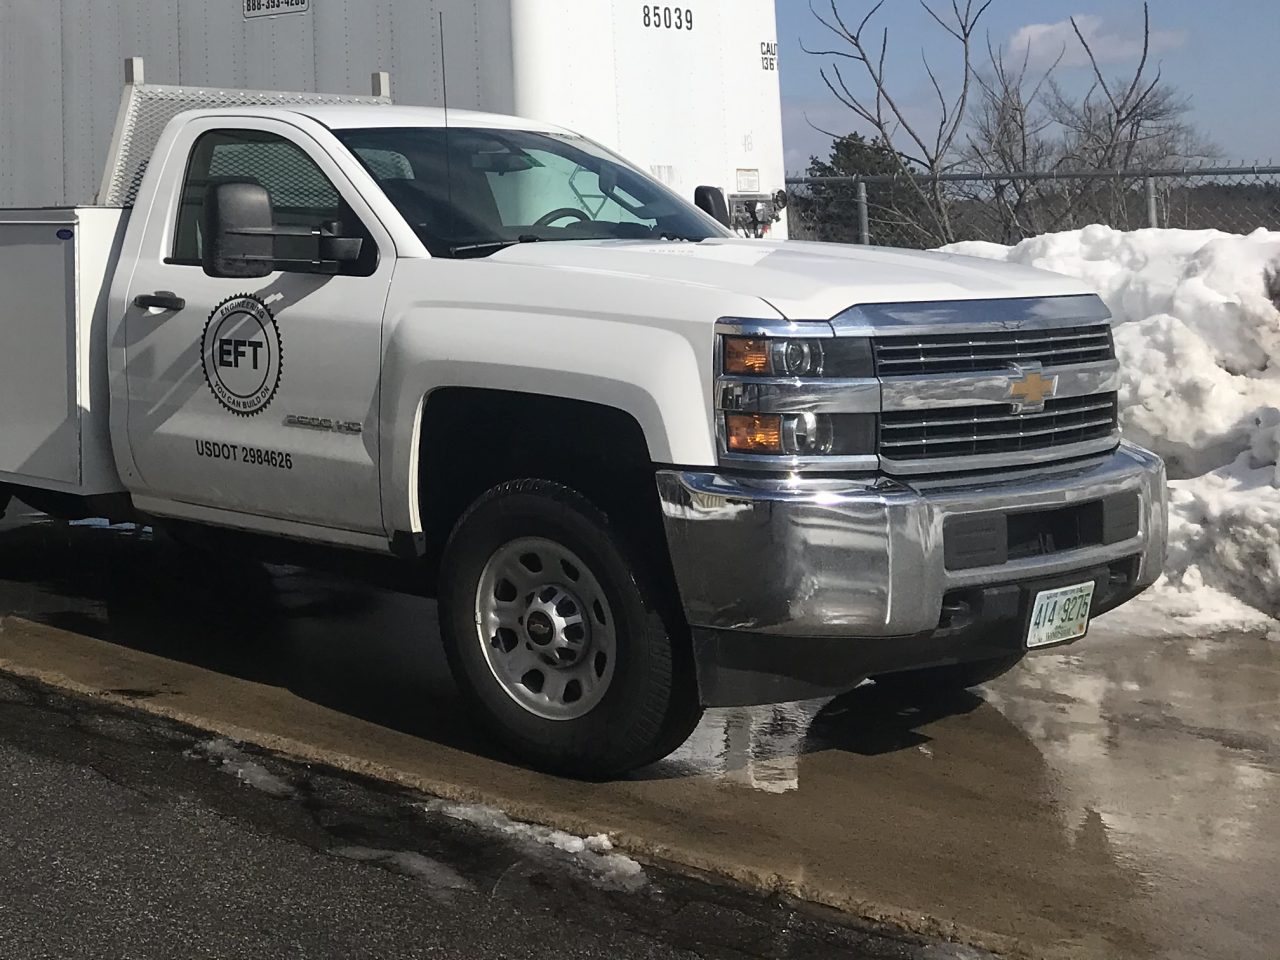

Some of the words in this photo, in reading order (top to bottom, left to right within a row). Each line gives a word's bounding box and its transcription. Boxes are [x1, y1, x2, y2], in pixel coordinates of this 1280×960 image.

[642, 5, 693, 31] 85039
[220, 300, 266, 320] ENGINEERING
[219, 339, 263, 370] EFT
[213, 380, 227, 399] YOU
[227, 395, 241, 408] CAN
[242, 394, 261, 409] BUILD
[260, 385, 270, 399] ON
[195, 439, 238, 461] USDOT
[241, 446, 293, 470] 2984626
[1033, 599, 1058, 629] 414
[1060, 592, 1091, 623] 9275
